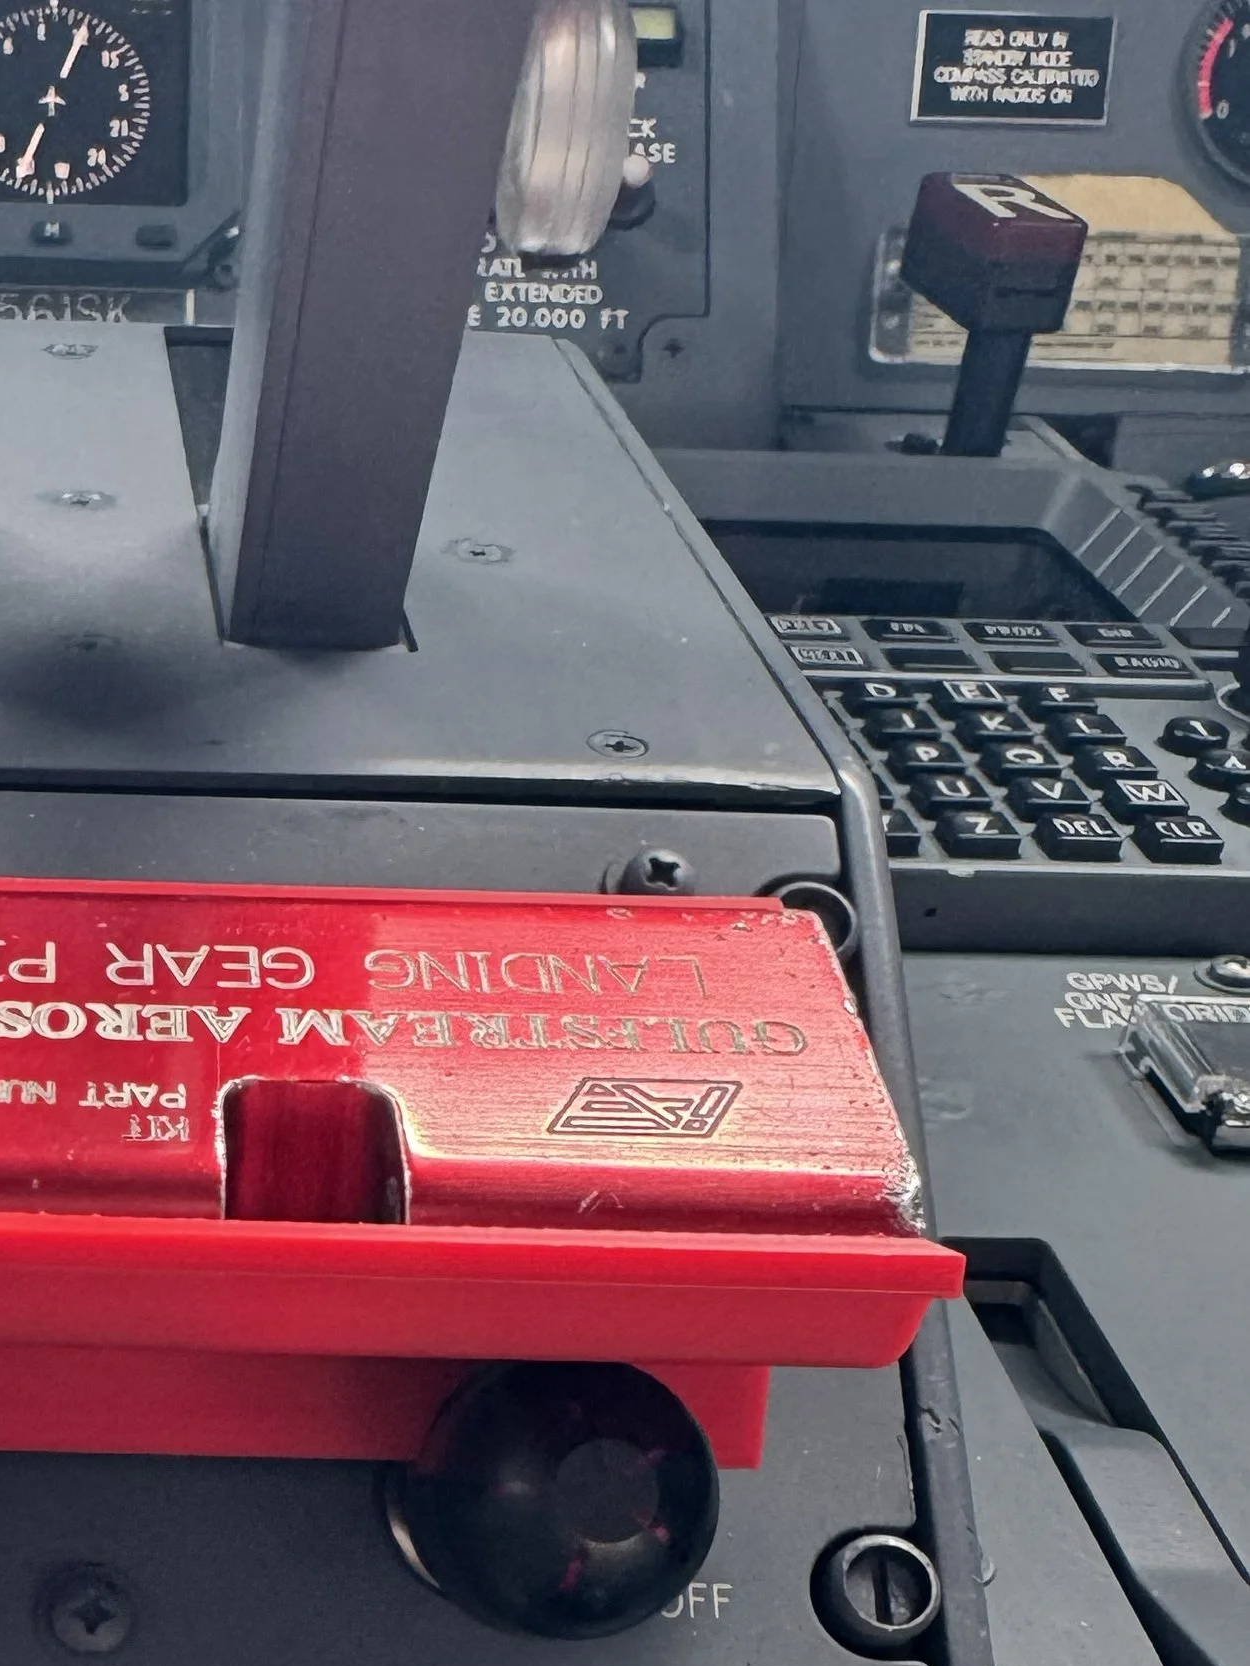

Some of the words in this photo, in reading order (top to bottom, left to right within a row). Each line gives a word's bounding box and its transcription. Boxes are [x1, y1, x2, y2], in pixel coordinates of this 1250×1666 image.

[1009, 30, 1048, 48] ONLY
[953, 183, 1077, 219] R
[485, 282, 604, 305] EXTENDED
[600, 307, 631, 330] FT
[865, 682, 897, 698] D
[979, 713, 1013, 731] K
[915, 745, 940, 762] P
[1103, 751, 1136, 768] R
[936, 780, 972, 798] U
[1031, 780, 1064, 800] V
[964, 817, 1000, 834] Z
[1052, 817, 1113, 836] DEL
[1154, 821, 1213, 838] CLR
[105, 941, 316, 991] GEAR
[364, 947, 709, 1000] LANDING
[1053, 1007, 1138, 1029] FLA
[274, 1006, 810, 1057] GULFSTREAM
[78, 1080, 188, 1110] PART
[121, 1113, 191, 1143] KIT
